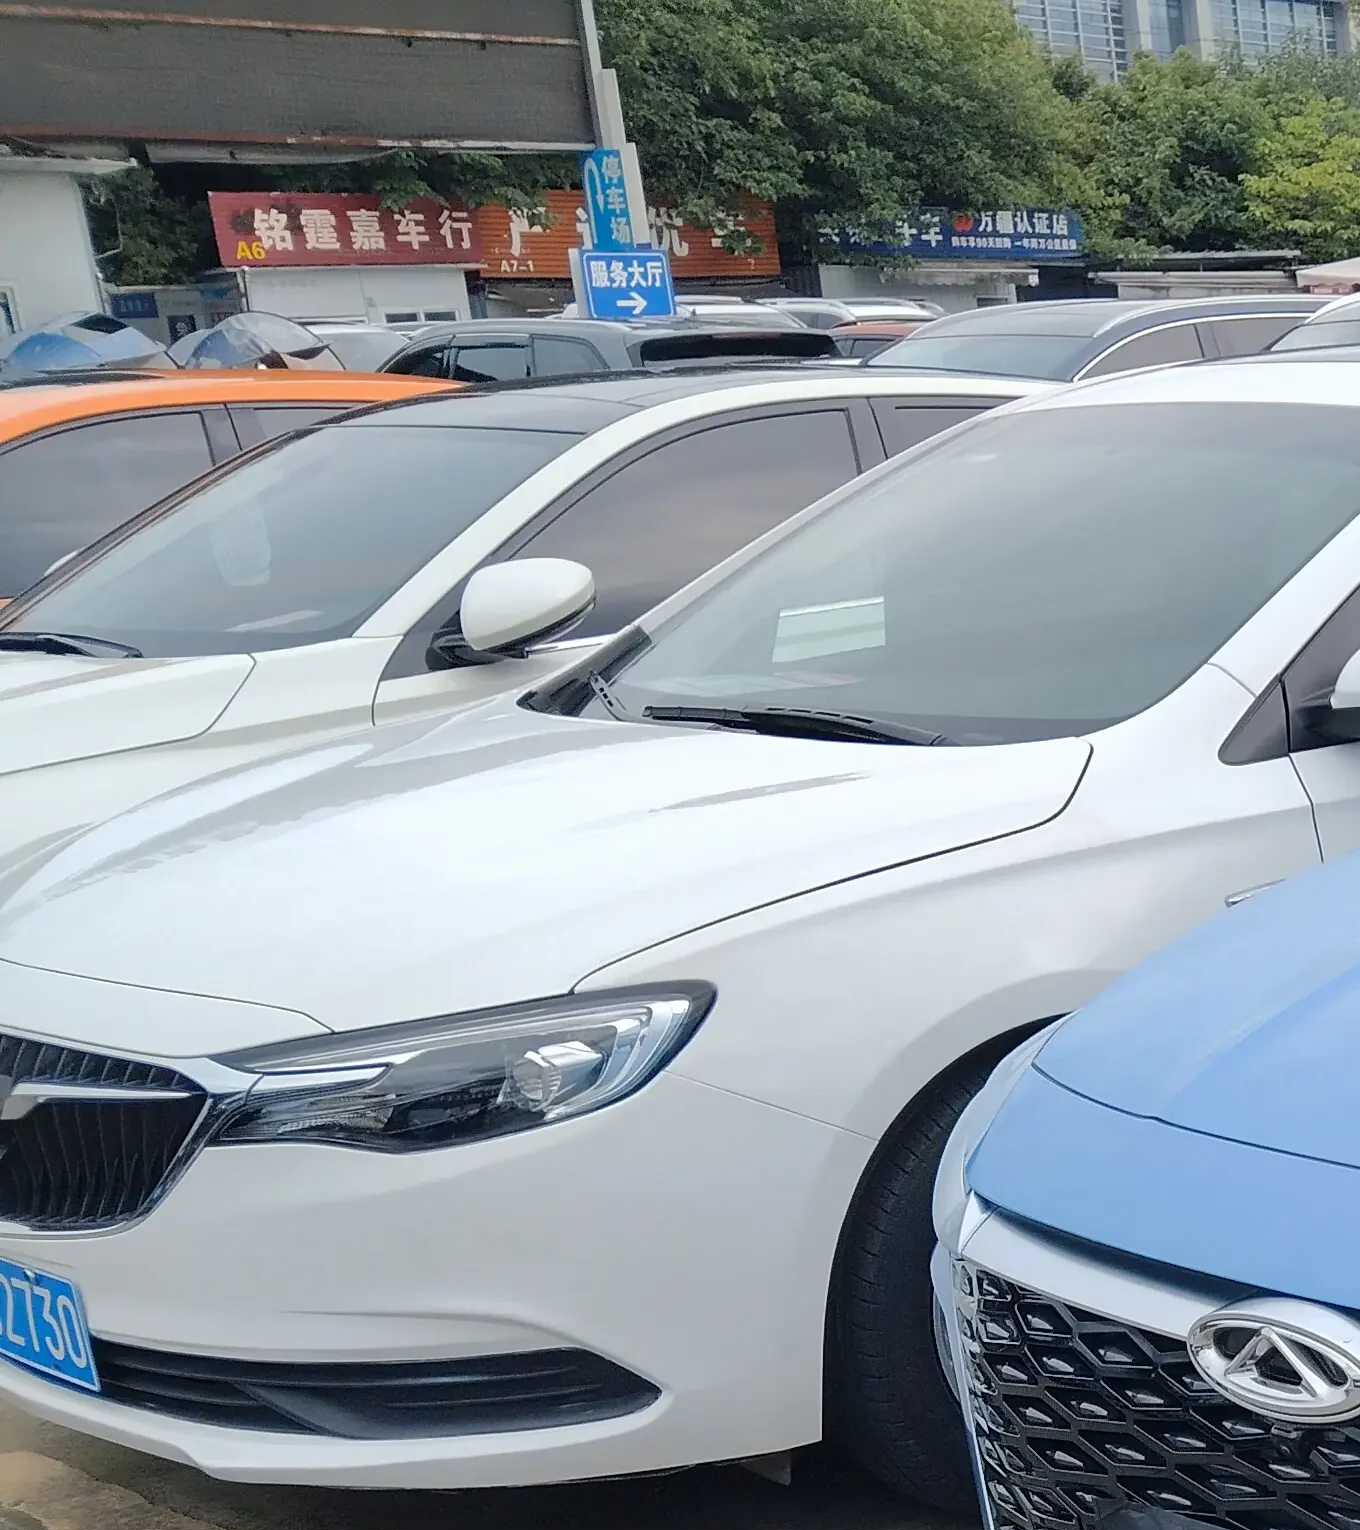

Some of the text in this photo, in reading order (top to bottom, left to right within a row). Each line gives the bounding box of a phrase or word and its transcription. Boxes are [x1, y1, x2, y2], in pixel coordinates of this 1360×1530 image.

[601, 155, 631, 244] 停车场
[253, 208, 473, 250] 铭霆嘉车行
[236, 241, 266, 260] A6
[500, 259, 534, 273] A7-1
[590, 260, 663, 288] 服务大厅
[0, 1273, 87, 1368] 2730
